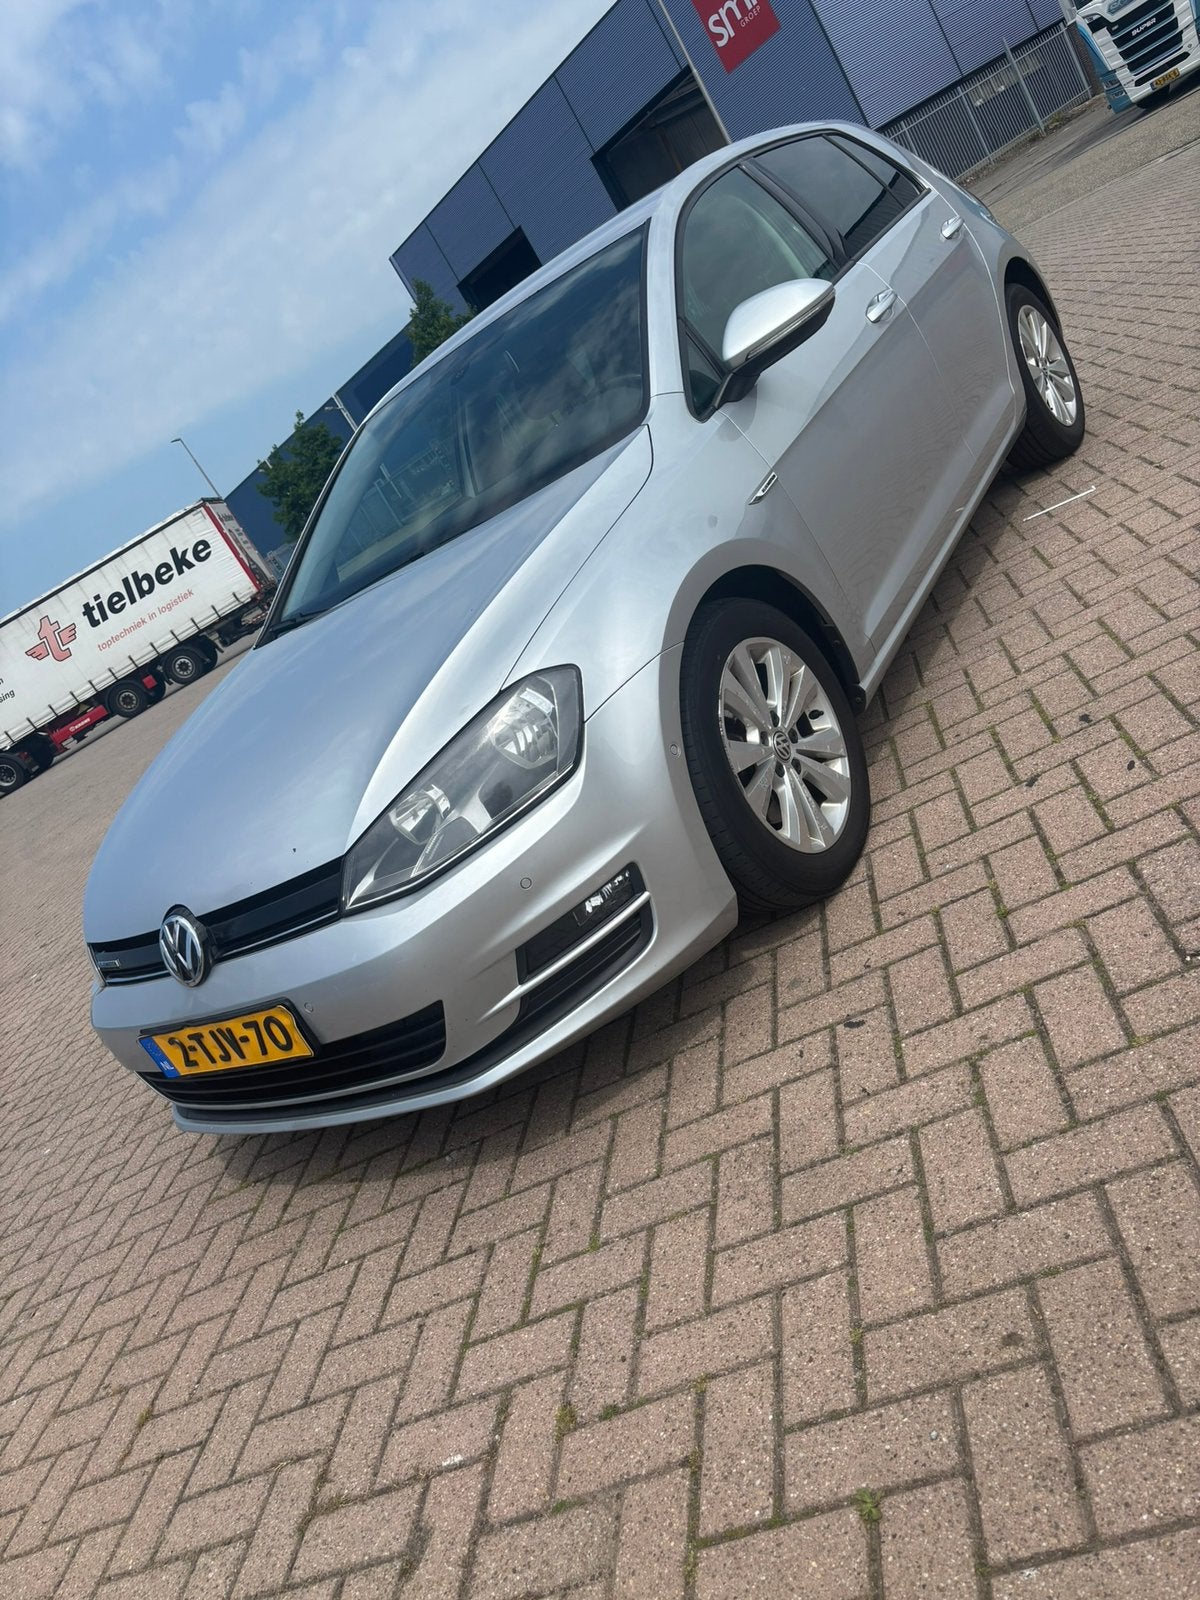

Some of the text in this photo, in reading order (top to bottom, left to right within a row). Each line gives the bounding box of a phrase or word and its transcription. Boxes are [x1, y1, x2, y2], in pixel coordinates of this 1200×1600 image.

[740, 5, 761, 27] GROEP
[1131, 17, 1157, 36] SUPER
[82, 538, 212, 628] tielbeke
[97, 588, 194, 651] toptechniek in logistiek
[167, 1015, 294, 1068] 2-TJV-70
